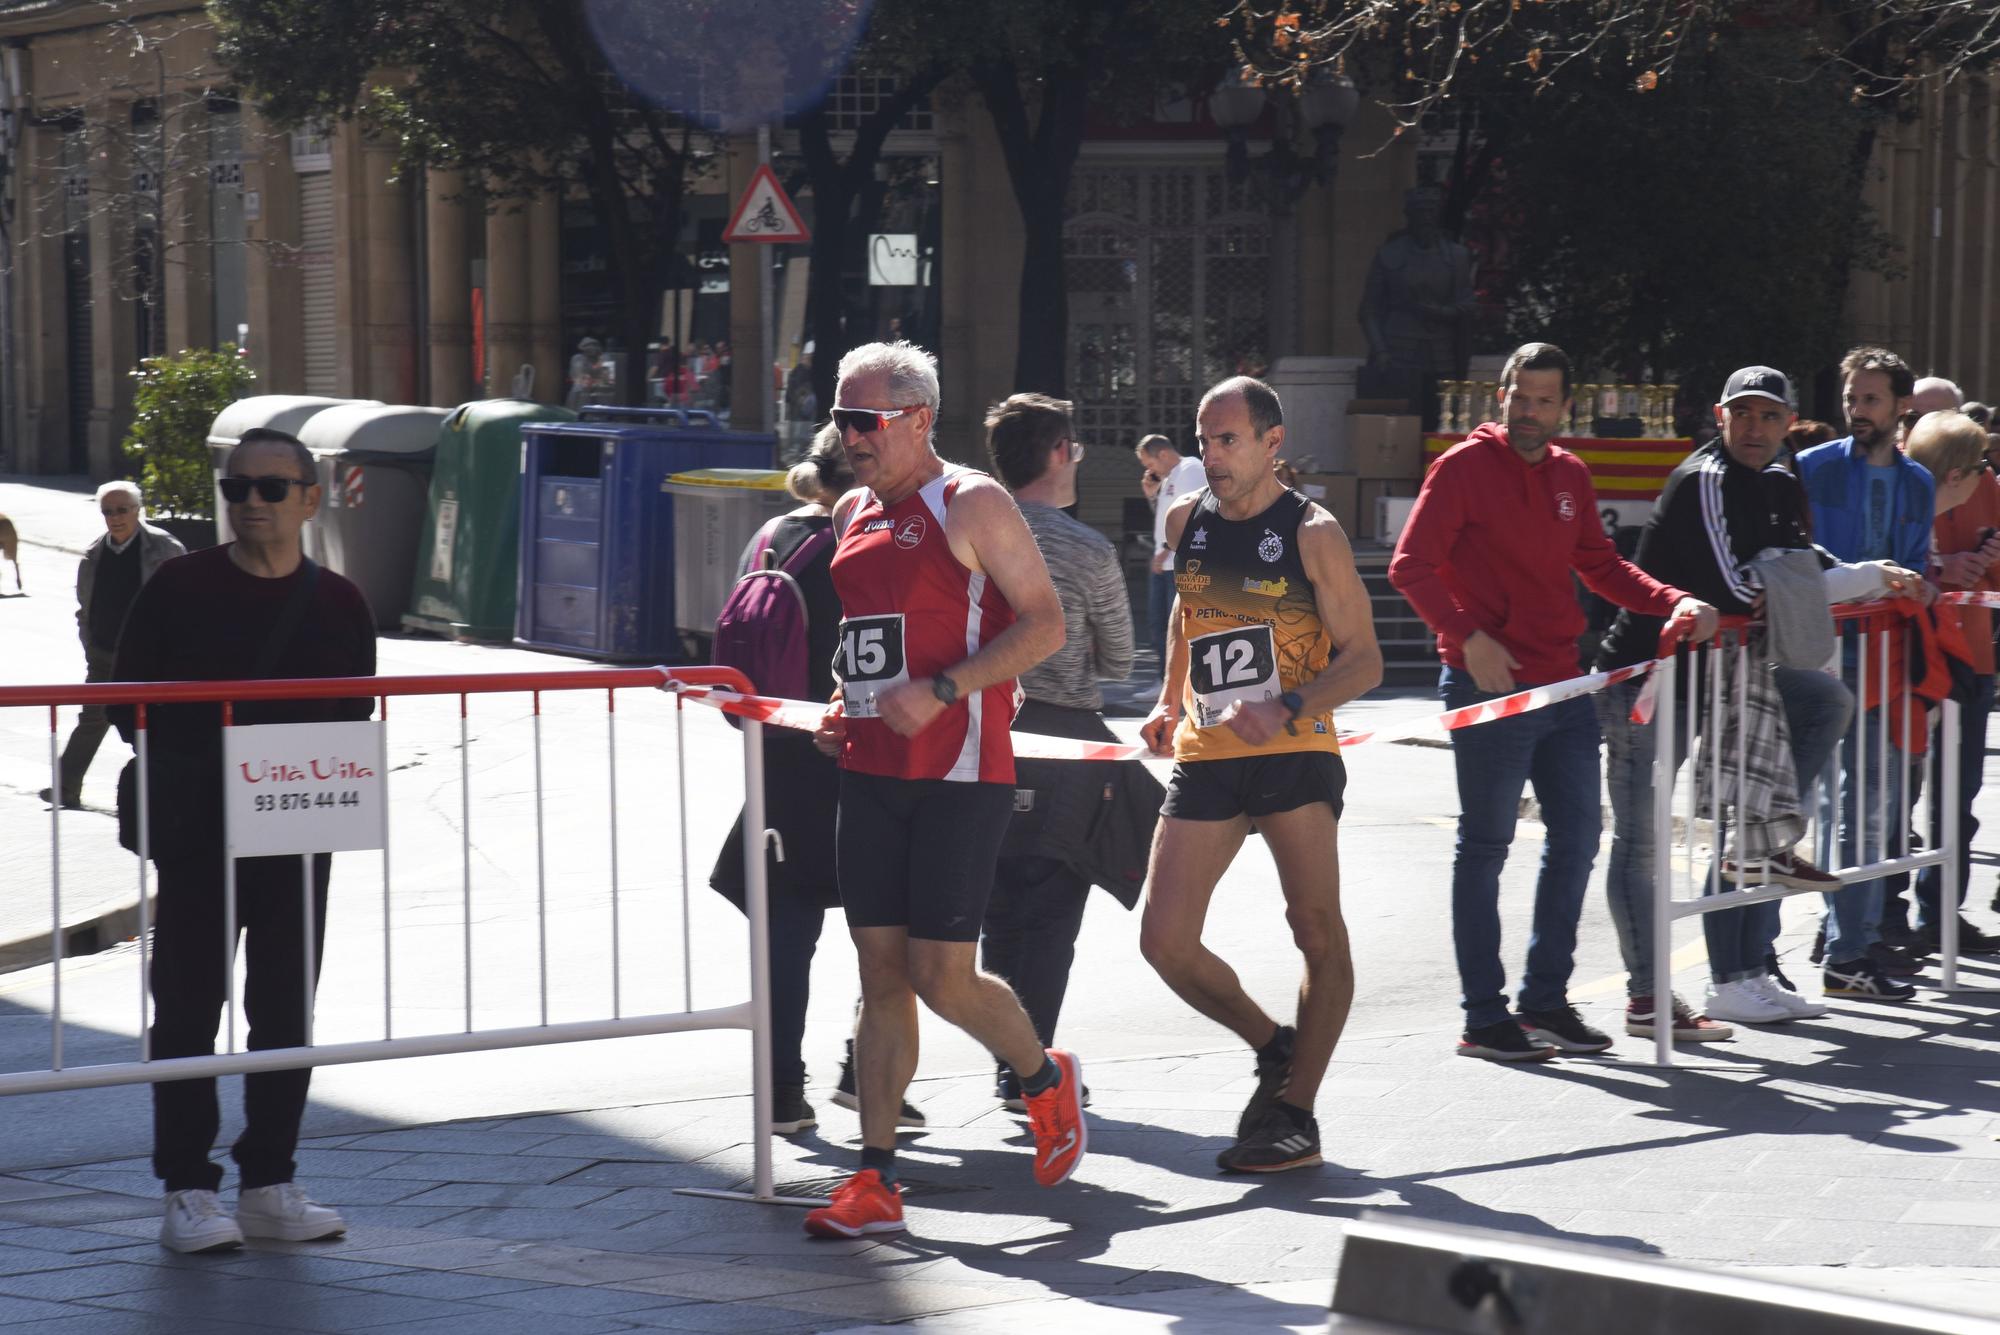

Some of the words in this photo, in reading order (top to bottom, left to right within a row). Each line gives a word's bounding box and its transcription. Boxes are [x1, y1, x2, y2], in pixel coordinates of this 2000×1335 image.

[842, 628, 886, 676] 15
[1202, 639, 1259, 687] 12
[255, 794, 275, 812] 93
[280, 792, 311, 811] 876
[315, 791, 335, 808] 44
[339, 790, 360, 807] 44
